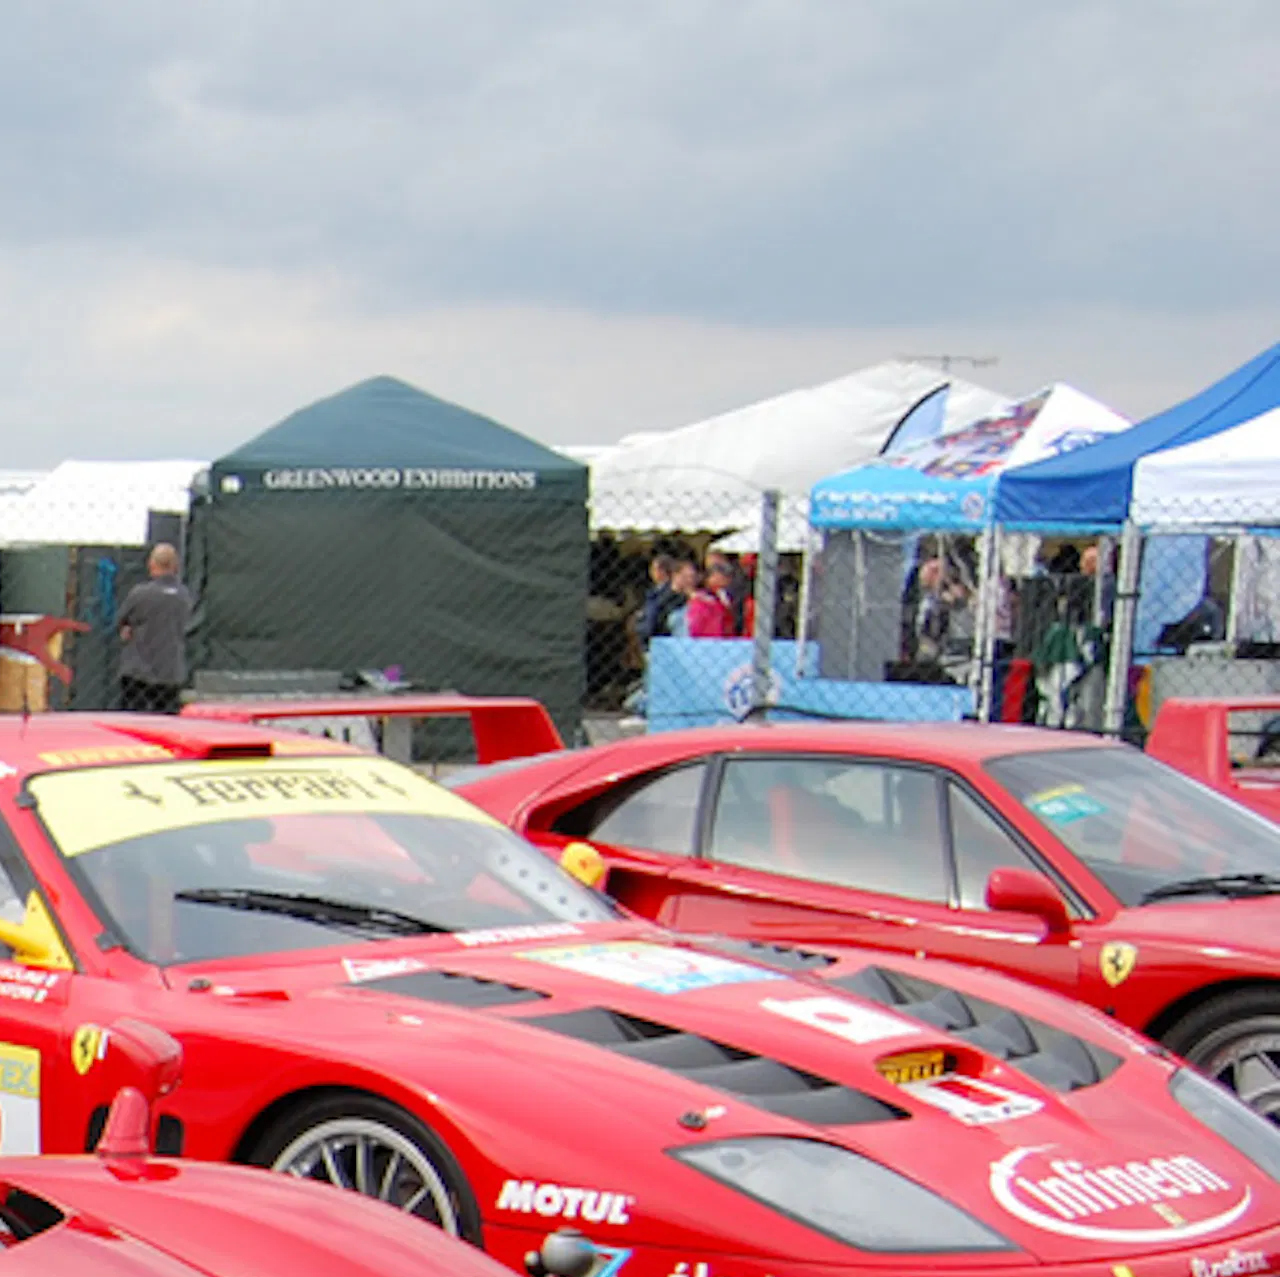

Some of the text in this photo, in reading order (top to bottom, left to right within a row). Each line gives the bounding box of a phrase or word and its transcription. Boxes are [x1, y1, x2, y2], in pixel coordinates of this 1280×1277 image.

[263, 467, 536, 490] GREENWOOD EXHIBITIONS
[164, 768, 378, 806] Ferrari
[495, 1179, 634, 1225] MOTUL
[1016, 1154, 1233, 1222] Infineon
